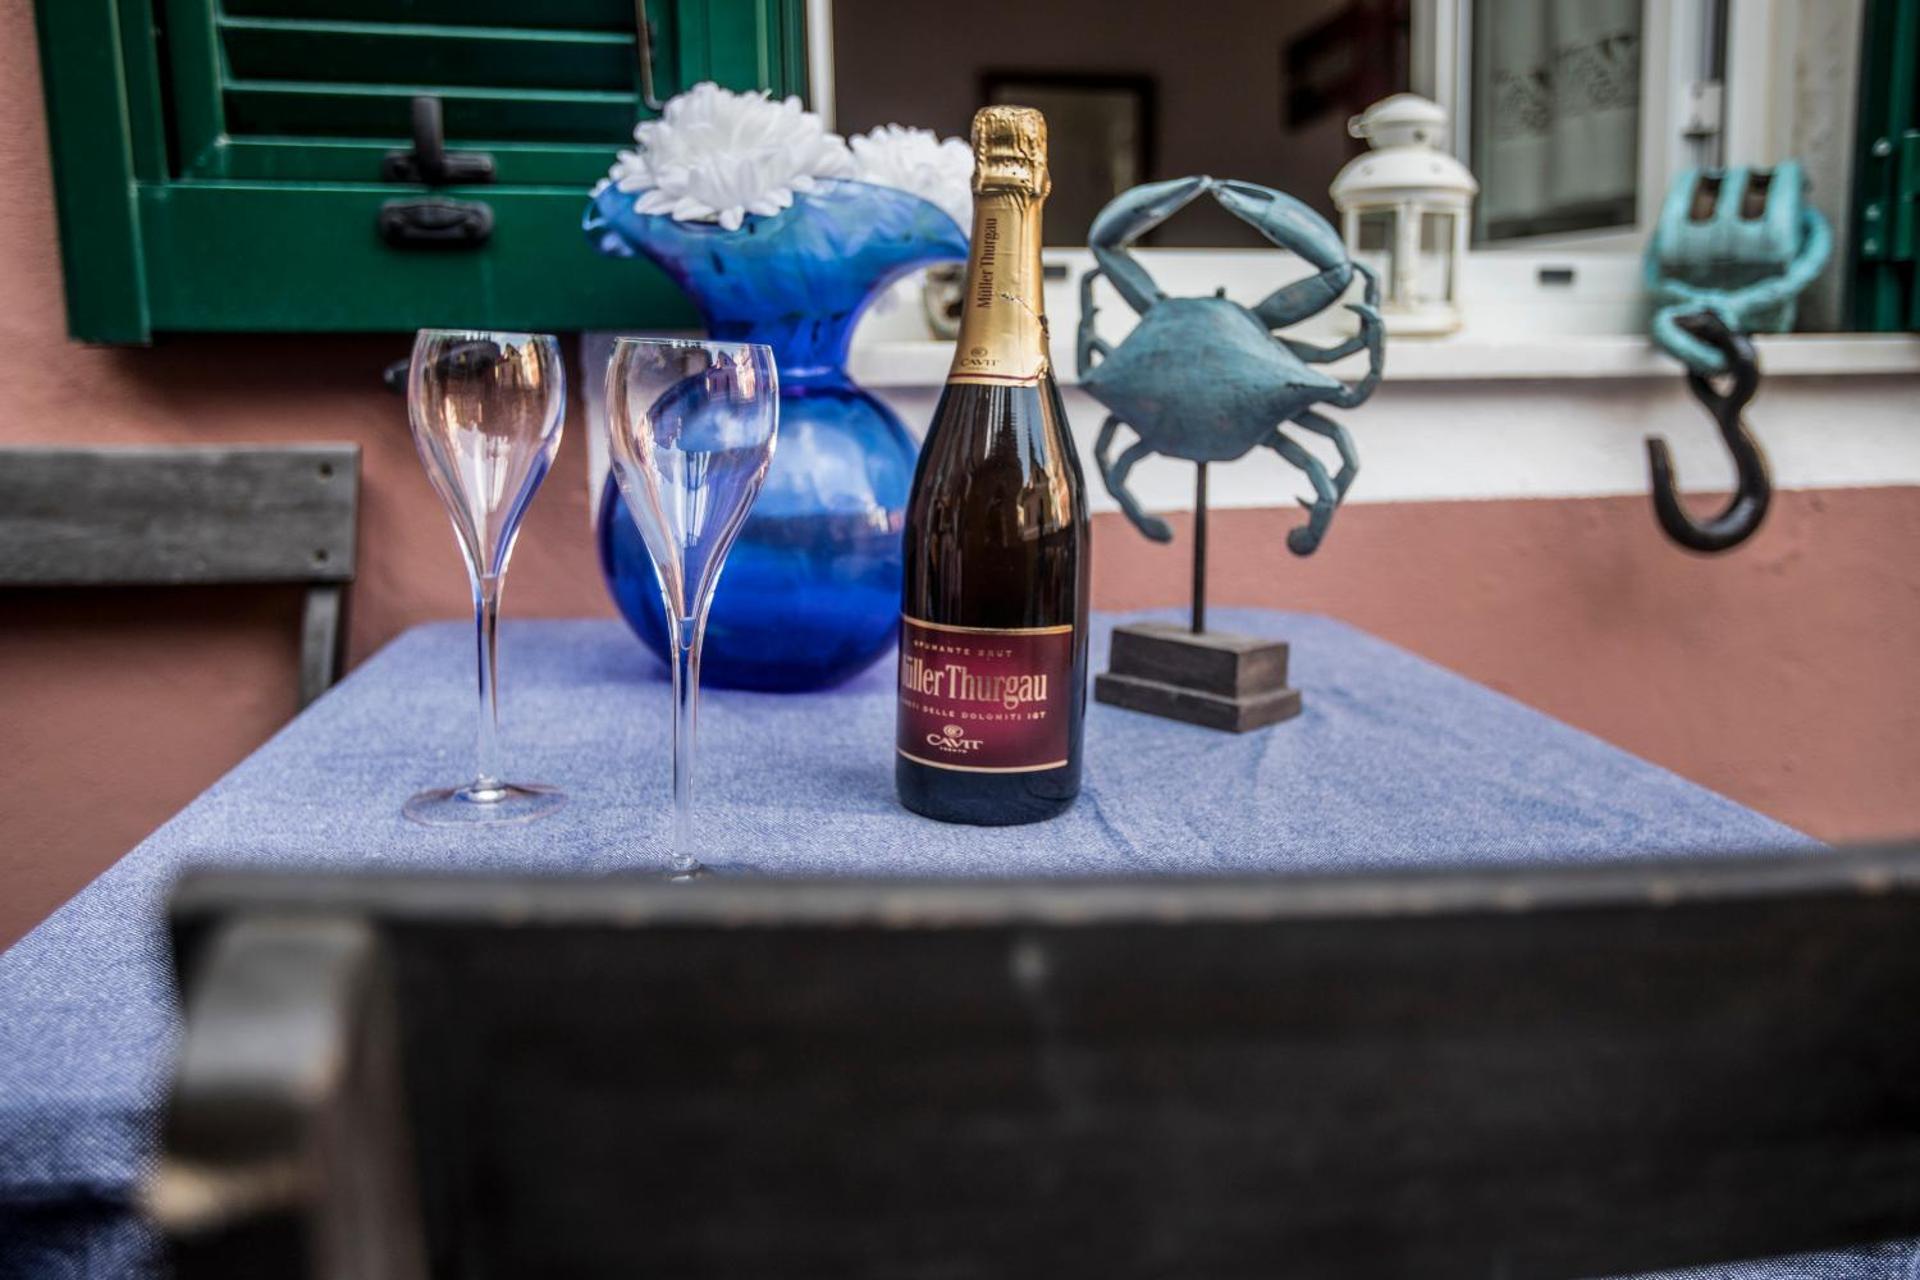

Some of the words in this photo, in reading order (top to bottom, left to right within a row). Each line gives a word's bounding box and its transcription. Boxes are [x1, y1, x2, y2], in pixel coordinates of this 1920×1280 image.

[980, 218, 999, 268] Thurgau
[976, 270, 994, 308] Müller
[945, 664, 1048, 710] Thurgau
[922, 705, 955, 718] DELLE
[961, 711, 1022, 721] DOLOMITI
[926, 733, 984, 750] CAVIT
